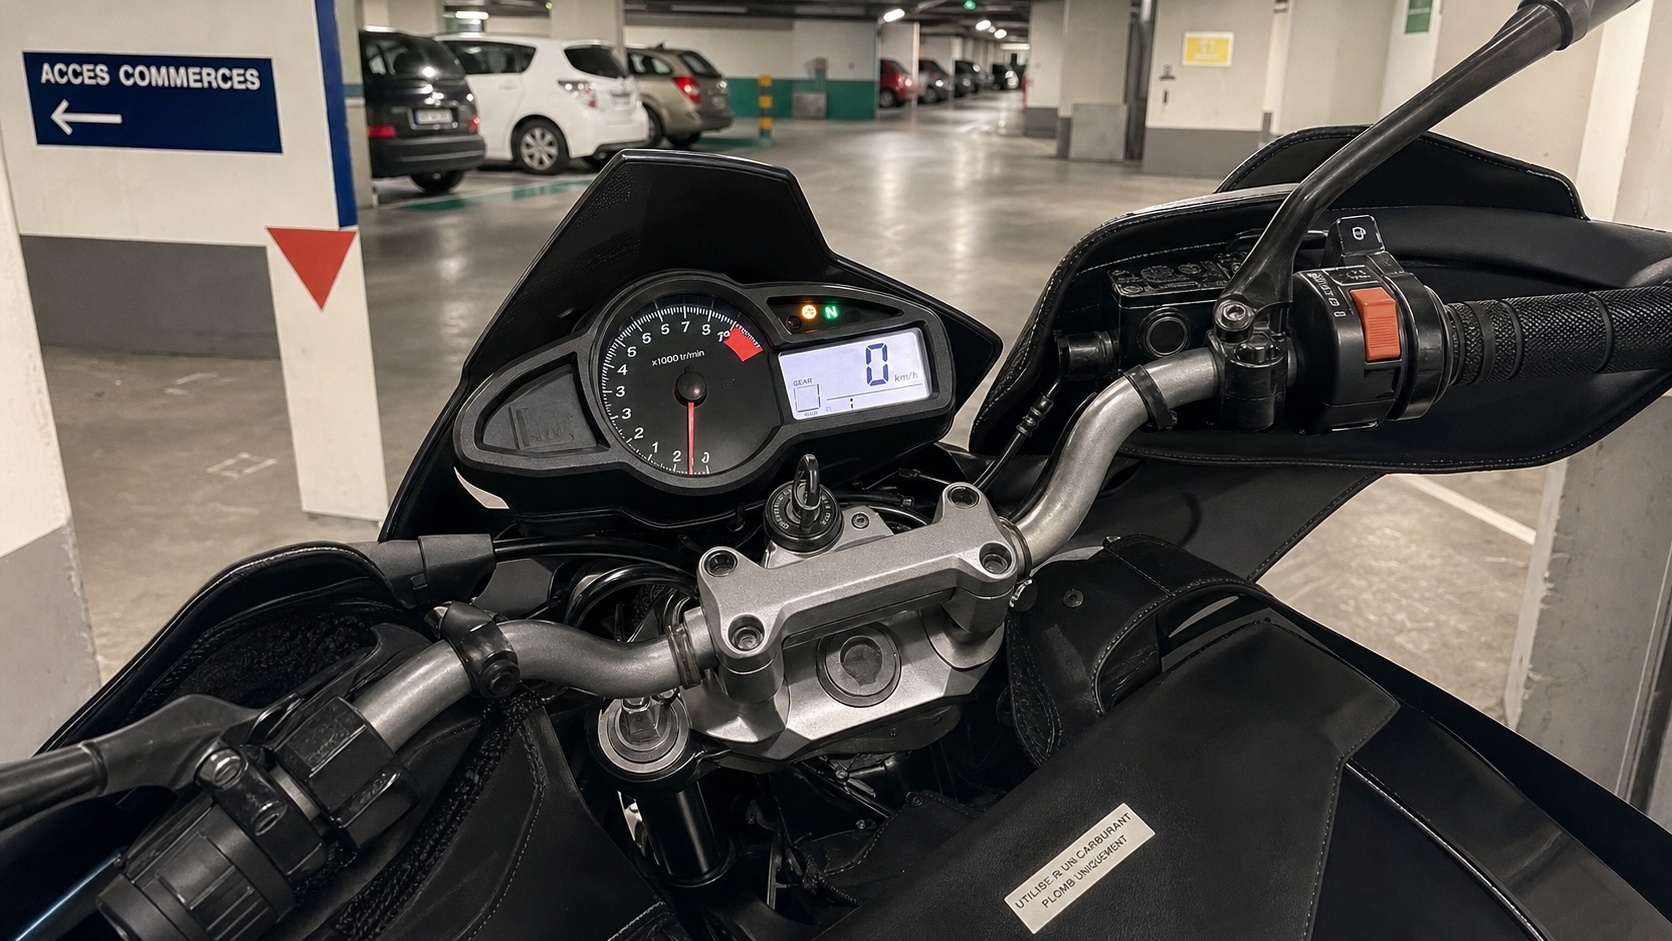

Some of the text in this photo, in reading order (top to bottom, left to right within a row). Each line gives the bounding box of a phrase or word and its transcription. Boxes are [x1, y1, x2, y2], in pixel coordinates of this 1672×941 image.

[41, 63, 261, 90] ACCES COMMERCES
[825, 305, 838, 319] N
[680, 320, 691, 333] 7
[651, 349, 705, 366] x1000 tr/min
[617, 363, 628, 376] 4
[865, 342, 889, 387] 0
[793, 377, 813, 388] GEAR
[894, 371, 919, 383] km/h
[615, 386, 626, 398] 3
[621, 407, 632, 420] 3
[633, 427, 644, 440] 2
[651, 441, 660, 454] 1
[672, 449, 682, 463] 2
[1041, 879, 1076, 909] PLOMB
